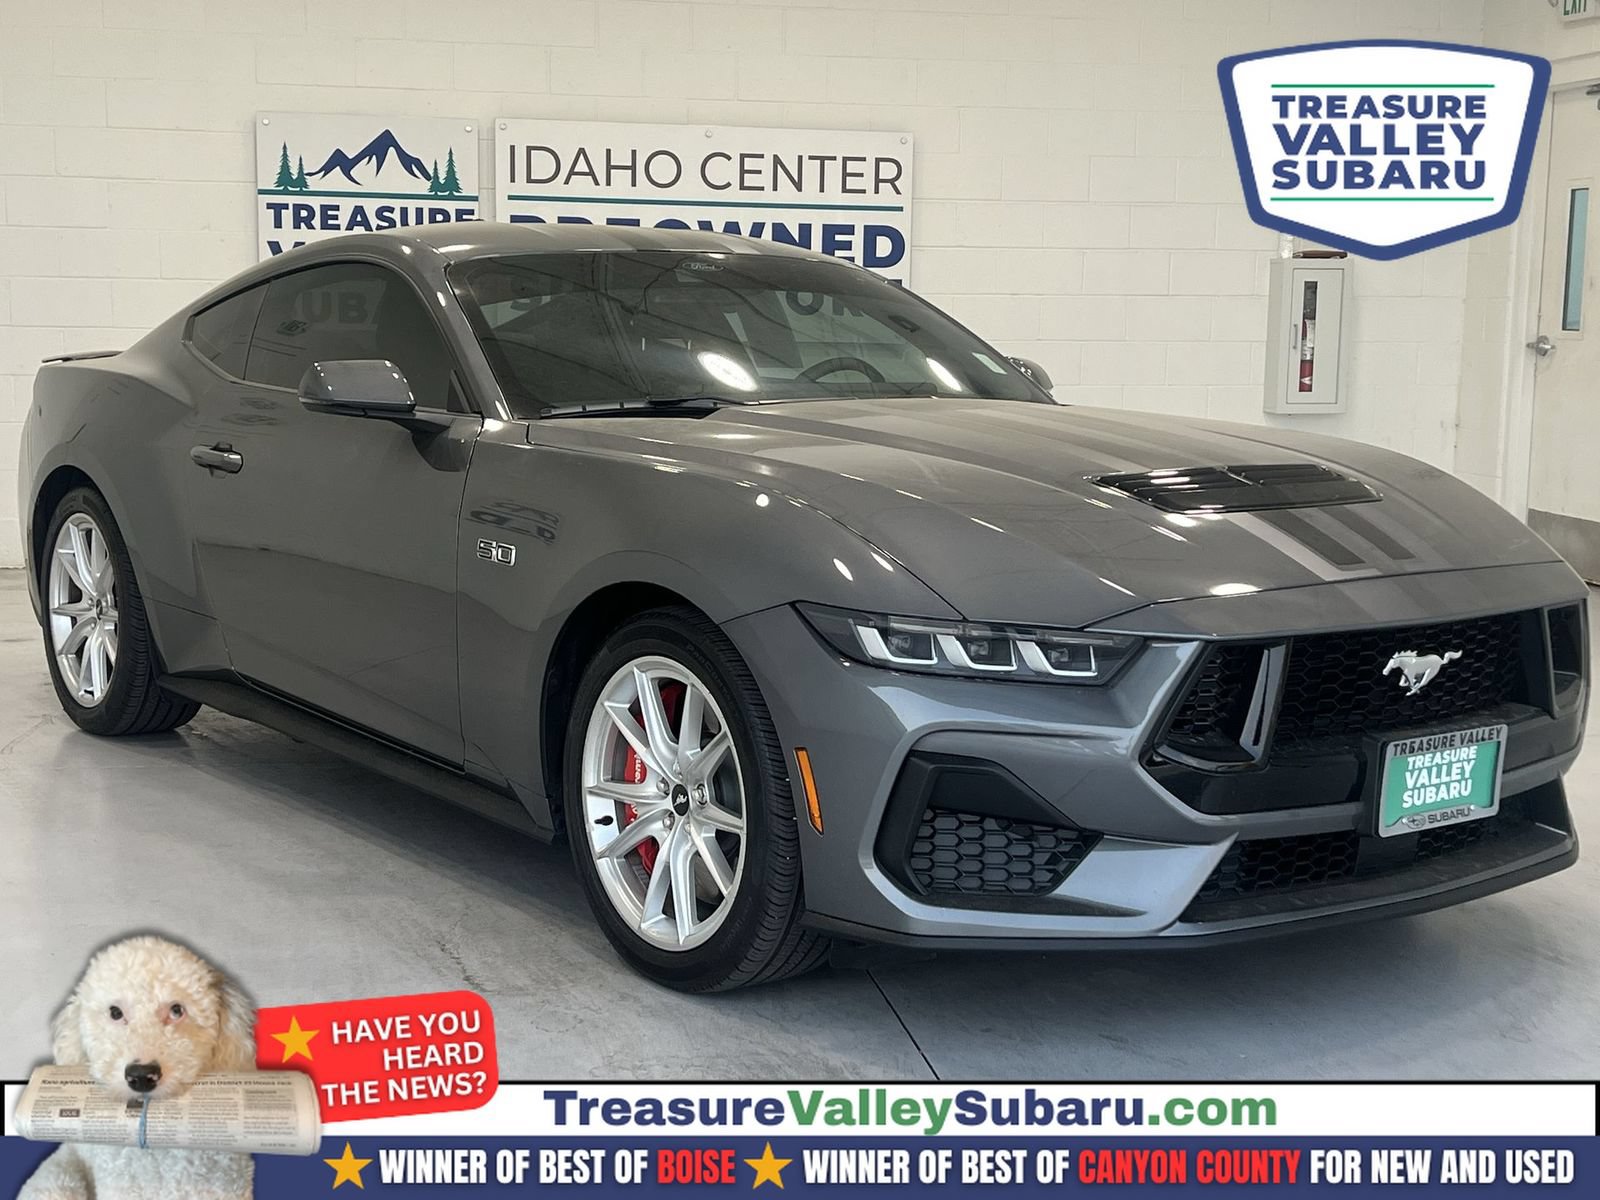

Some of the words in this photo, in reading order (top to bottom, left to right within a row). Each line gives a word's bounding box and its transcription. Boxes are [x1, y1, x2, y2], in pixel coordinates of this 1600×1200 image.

[509, 144, 682, 189] IDAHO
[699, 151, 902, 195] CENTER
[1393, 734, 1456, 756] TREASURE
[1460, 726, 1503, 745] VALLEY
[1407, 745, 1478, 770] TREASURE
[1405, 759, 1475, 789] VALLEY
[1402, 779, 1472, 808] SUBARU
[1428, 808, 1471, 823] SUBARU
